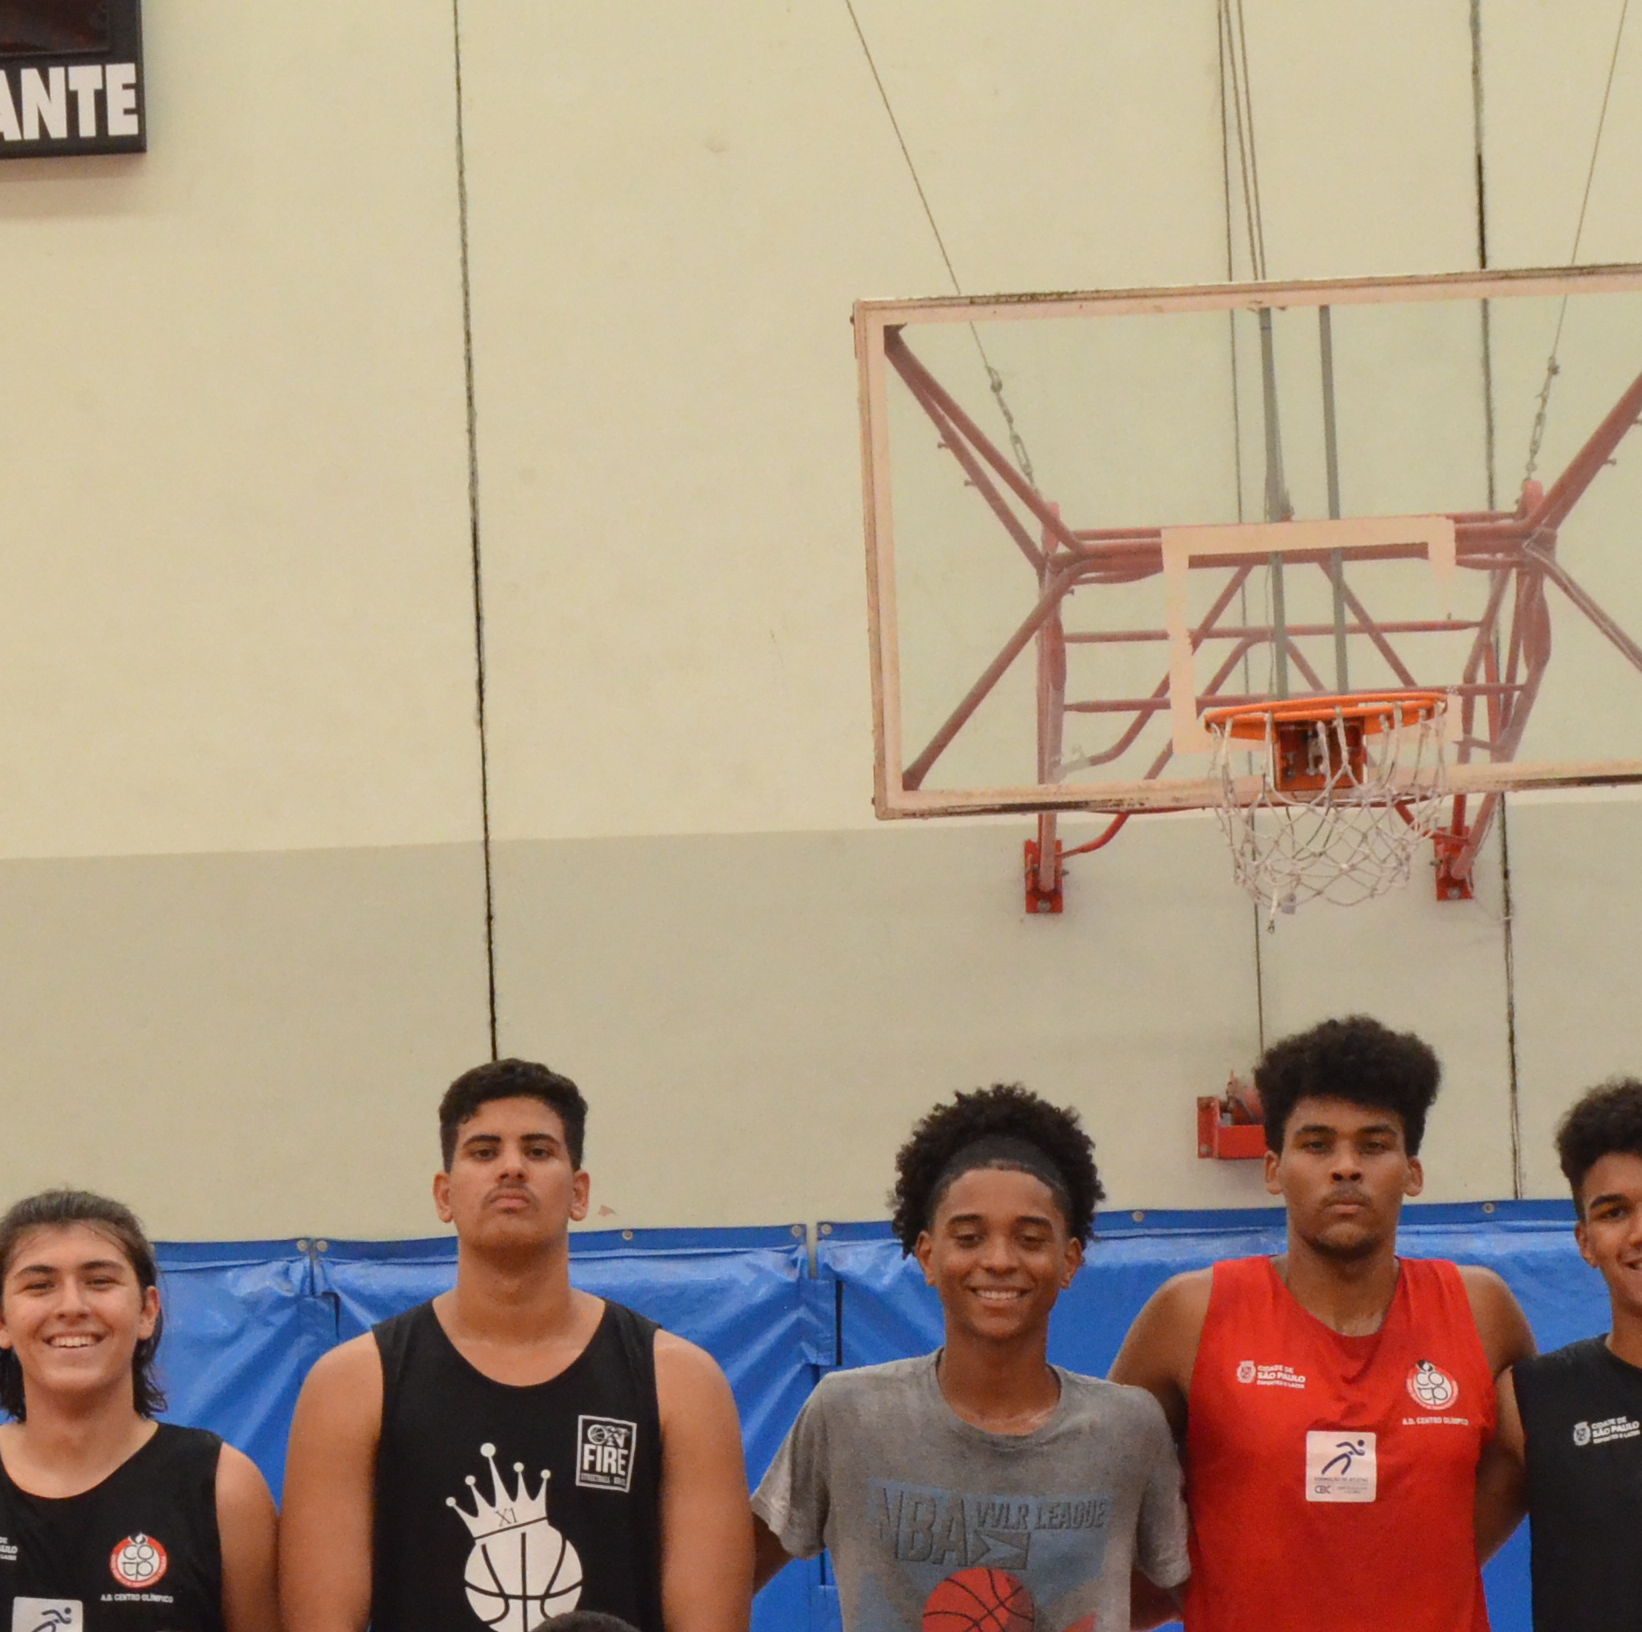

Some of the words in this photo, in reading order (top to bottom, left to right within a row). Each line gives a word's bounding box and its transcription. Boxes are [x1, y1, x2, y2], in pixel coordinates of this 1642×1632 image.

[1257, 1371, 1276, 1379] SÃO
[1277, 1372, 1306, 1383] PAULO
[1285, 1366, 1294, 1374] DE
[1611, 1421, 1640, 1432] PAULO
[583, 1444, 629, 1476] FIRE
[495, 1508, 518, 1527] X1
[877, 1487, 968, 1567] NBA
[1035, 1498, 1108, 1530] LEAGUE
